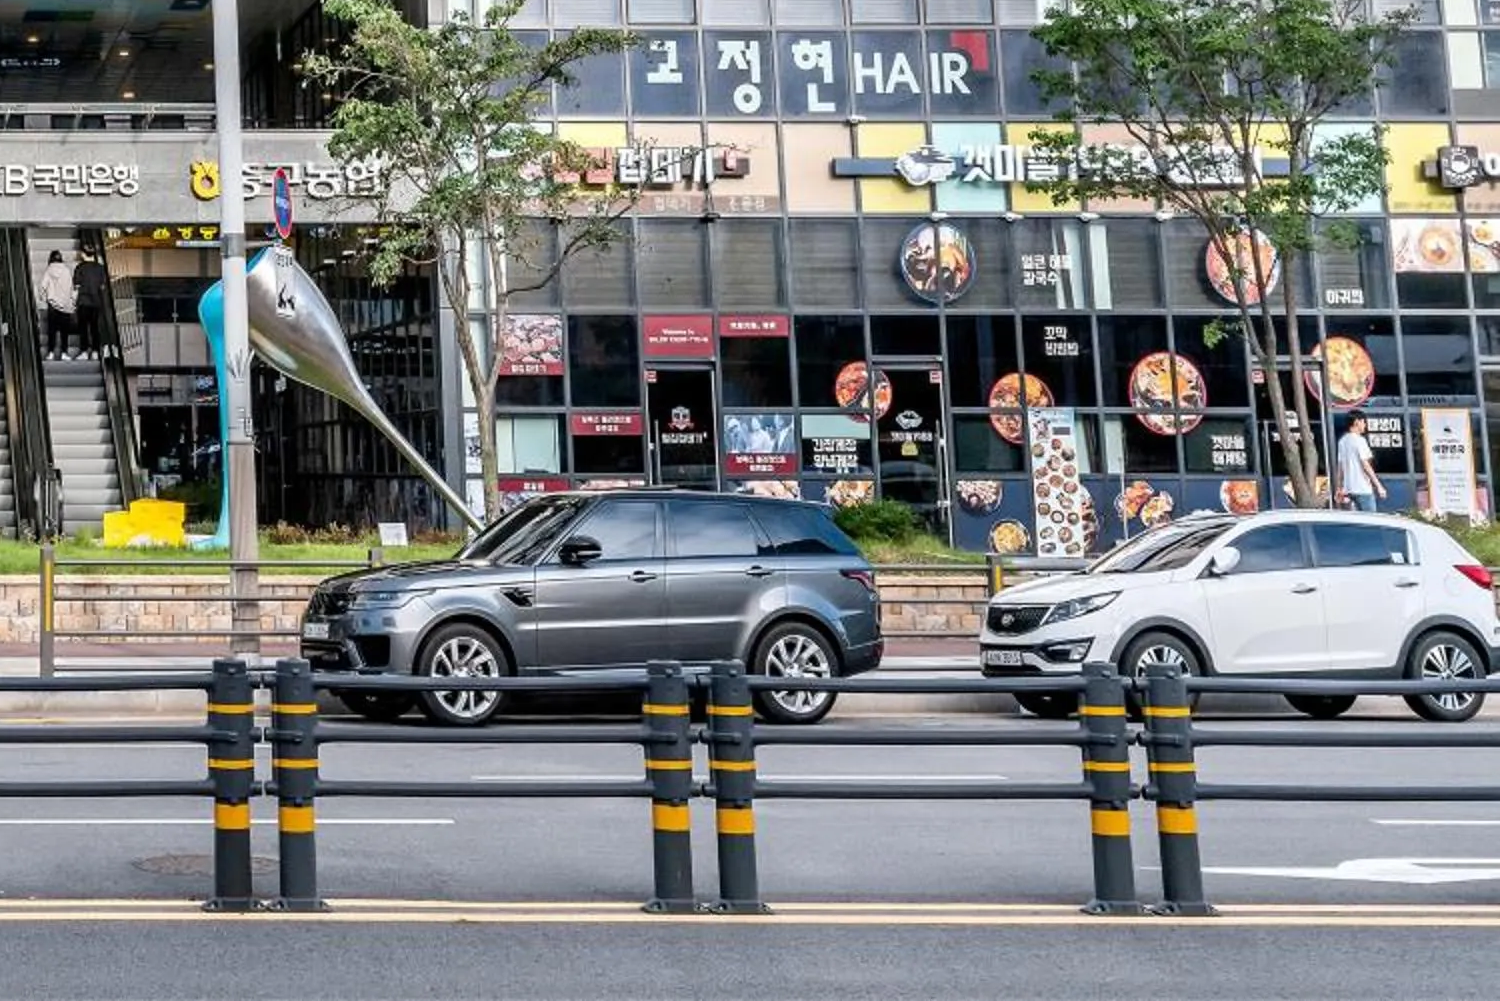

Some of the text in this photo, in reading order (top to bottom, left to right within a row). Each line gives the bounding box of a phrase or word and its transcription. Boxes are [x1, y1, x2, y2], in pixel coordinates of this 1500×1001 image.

[1021, 254, 1047, 270] 얼큰
[1023, 270, 1060, 286] 칼국수
[1043, 326, 1067, 340] 꼬막
[811, 438, 857, 452] 간장게장
[813, 454, 858, 468] 양념게장
